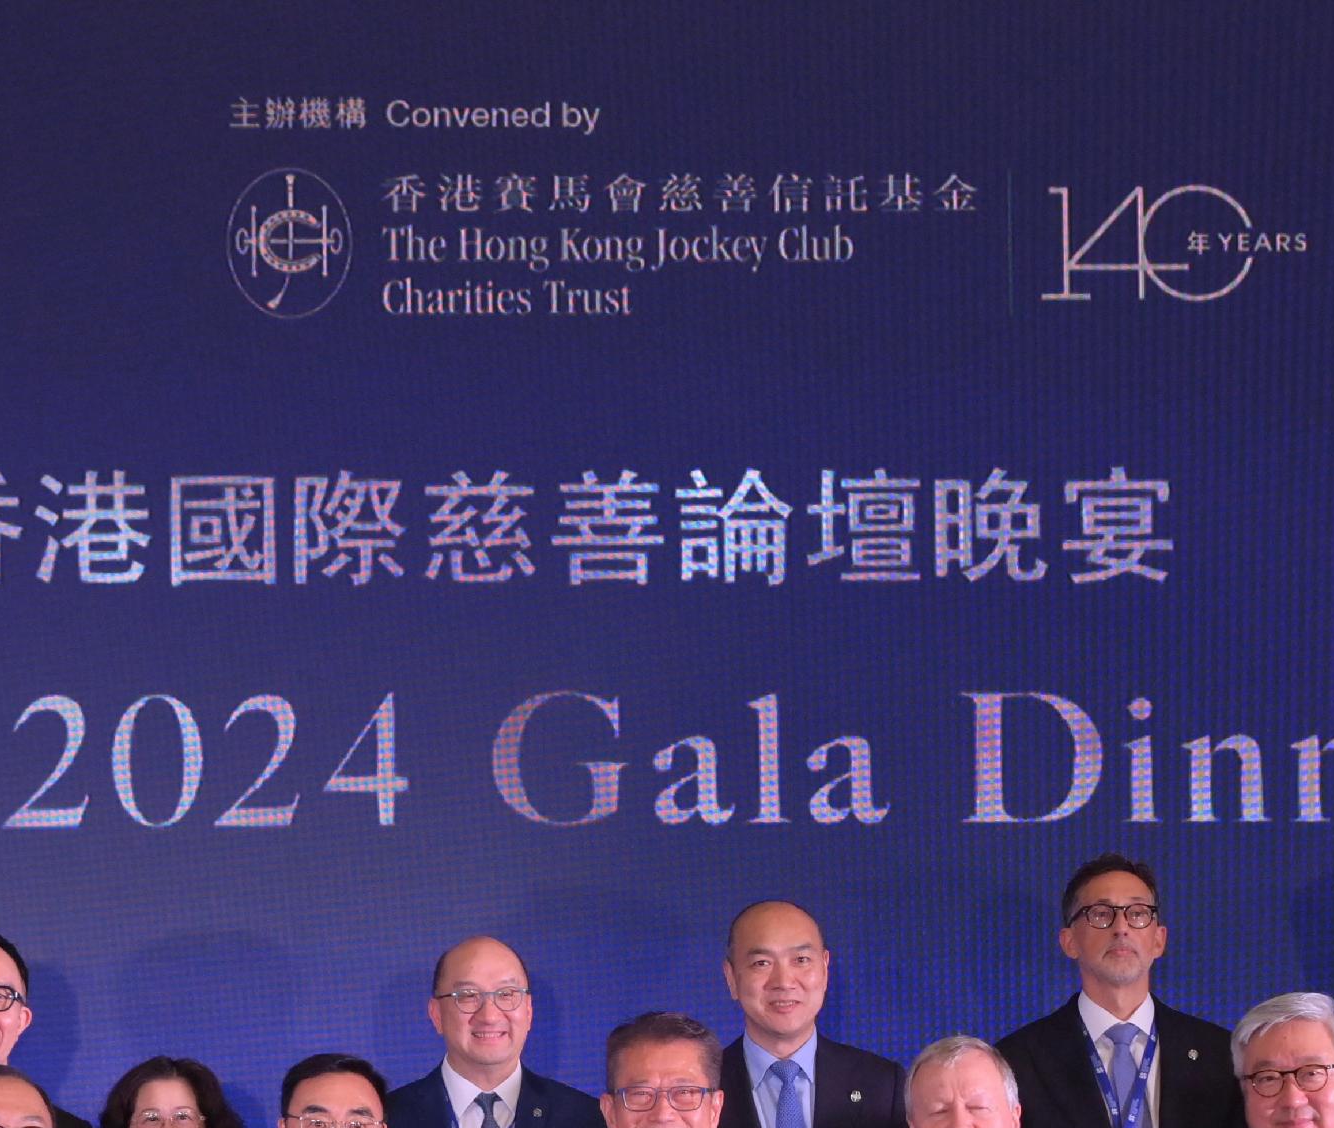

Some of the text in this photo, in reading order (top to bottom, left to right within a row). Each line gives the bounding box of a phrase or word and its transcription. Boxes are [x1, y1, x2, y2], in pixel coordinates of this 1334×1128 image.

[229, 94, 367, 129] 主辦機構
[386, 99, 601, 136] Convened by
[382, 172, 977, 214] 香港賽馬會慈善信託基金
[382, 224, 854, 273] The Hong Kong Jockey Club
[1042, 185, 1254, 301] 140
[1187, 230, 1307, 255] 年 YEARS
[382, 277, 630, 315] Charities Trust
[1, 691, 410, 830] 2024
[492, 690, 891, 828] Gala
